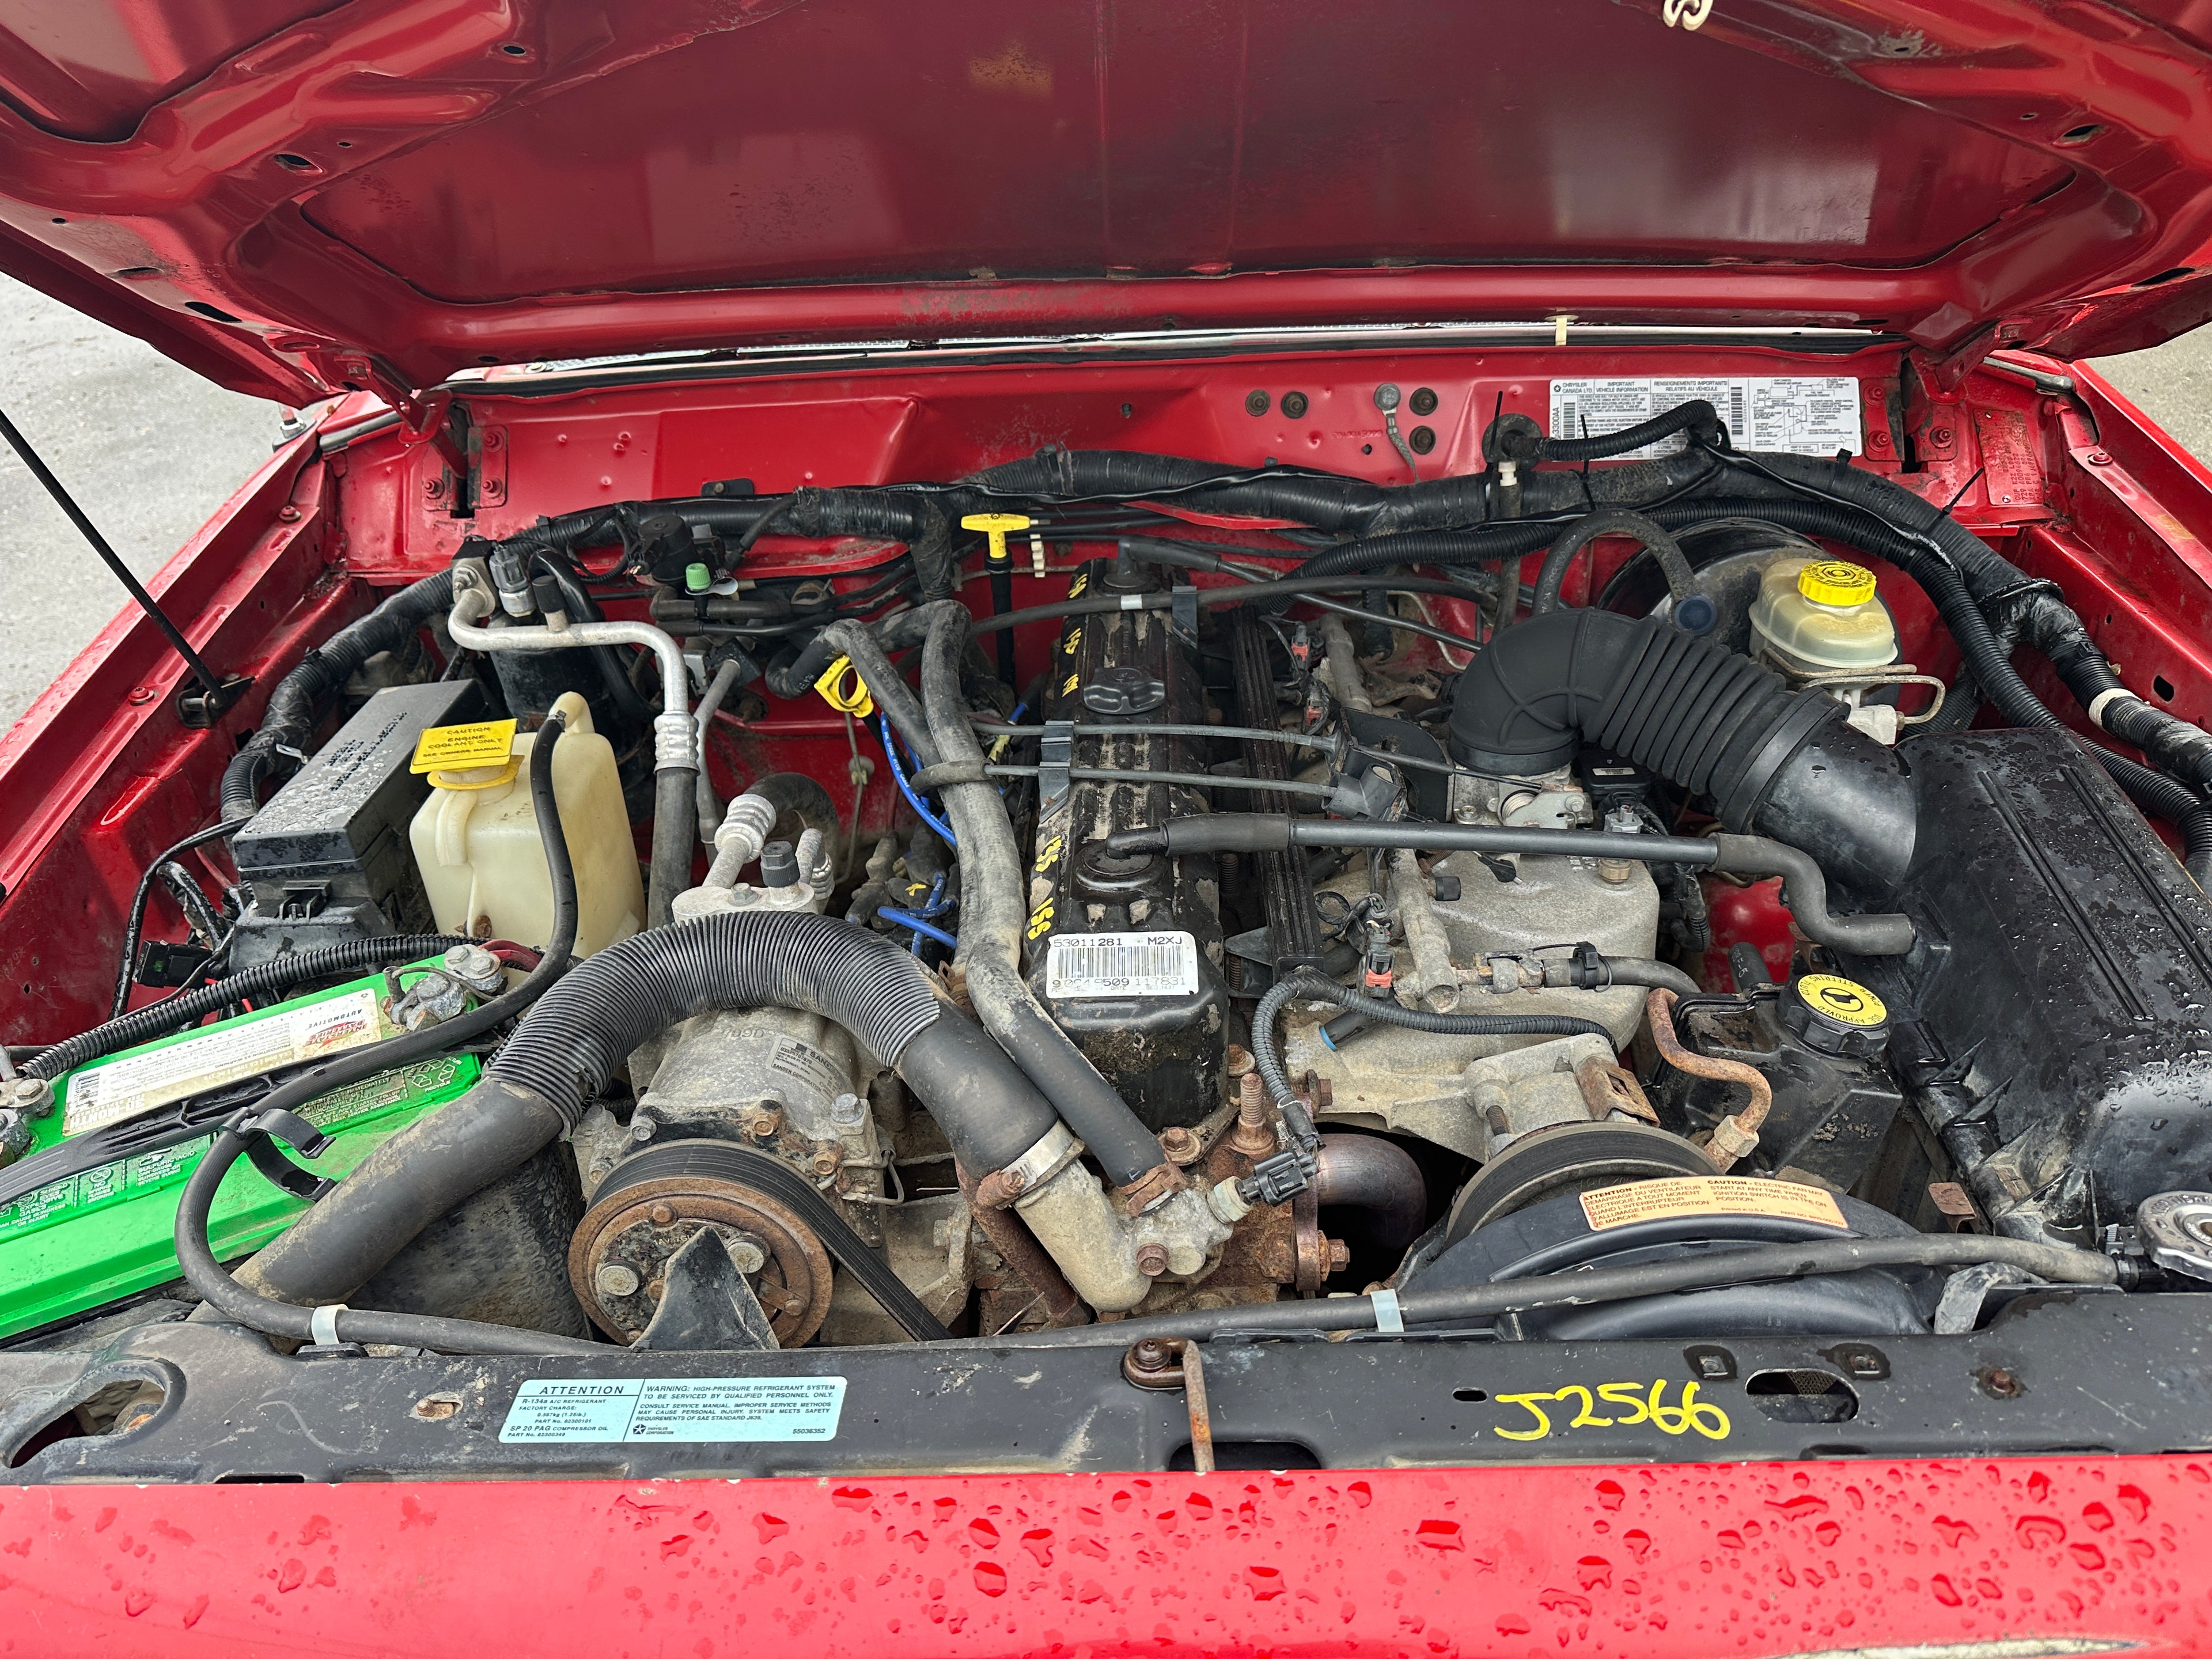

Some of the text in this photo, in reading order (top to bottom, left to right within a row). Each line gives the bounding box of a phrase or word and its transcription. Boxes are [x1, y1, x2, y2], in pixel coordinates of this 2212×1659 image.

[447, 727, 490, 735] CAUTION
[428, 741, 474, 749] COOLANT
[1028, 897, 1055, 940] 155
[1054, 936, 1182, 947] 53011281 M2XJ
[1808, 975, 1855, 987] STEERING
[1859, 988, 1882, 1006] POWER
[308, 1009, 363, 1029] AUTOMOTIVE
[1817, 1005, 1865, 1024] APPROVED
[1868, 1014, 1883, 1023] USE
[302, 1023, 367, 1047] INTERSTATE
[309, 1019, 365, 1040] BATTERIES
[215, 1043, 291, 1069] PROPOSITION WARNING
[773, 1063, 792, 1074] SANDEN
[792, 1071, 822, 1093] CORPORATION
[346, 1077, 390, 1094] IMMEDIATELY
[425, 1080, 451, 1092] RECYCLE
[350, 1089, 364, 1098] GET
[305, 1105, 336, 1117] MEDICAL
[338, 1099, 354, 1108] HELP
[310, 1115, 322, 1123] FOR
[323, 1111, 336, 1119] SAFE
[339, 1105, 353, 1113] JUMP
[347, 1108, 369, 1118] SERVICE
[69, 1099, 145, 1130] 30-MONTH
[138, 1151, 196, 1173] SULFURIC ACID
[151, 1163, 172, 1174] CAUSE
[94, 1180, 106, 1188] NO
[138, 1175, 160, 1186] SEVERE
[1753, 1181, 1791, 1191] ELECTRIC
[39, 1182, 69, 1195] SHIELD
[88, 1184, 112, 1195] SPARKS
[1584, 1187, 1632, 1200] ATTENTION
[1647, 1185, 1702, 1194] VENTILATEUR
[39, 1190, 60, 1201] EYES
[1749, 1191, 1780, 1199] SWITCH
[19, 1194, 63, 1213] EXPLOSIVE
[1589, 1196, 1684, 1217] QUAND L'INTERRUPTEUR
[1672, 1199, 1710, 1207] POSITION
[18, 1204, 47, 1217] GASES
[11, 1215, 32, 1225] CAUSE
[28, 1213, 50, 1224] INJURY
[539, 1385, 624, 1395] ATTENTION
[1494, 1379, 1731, 1441] J2566
